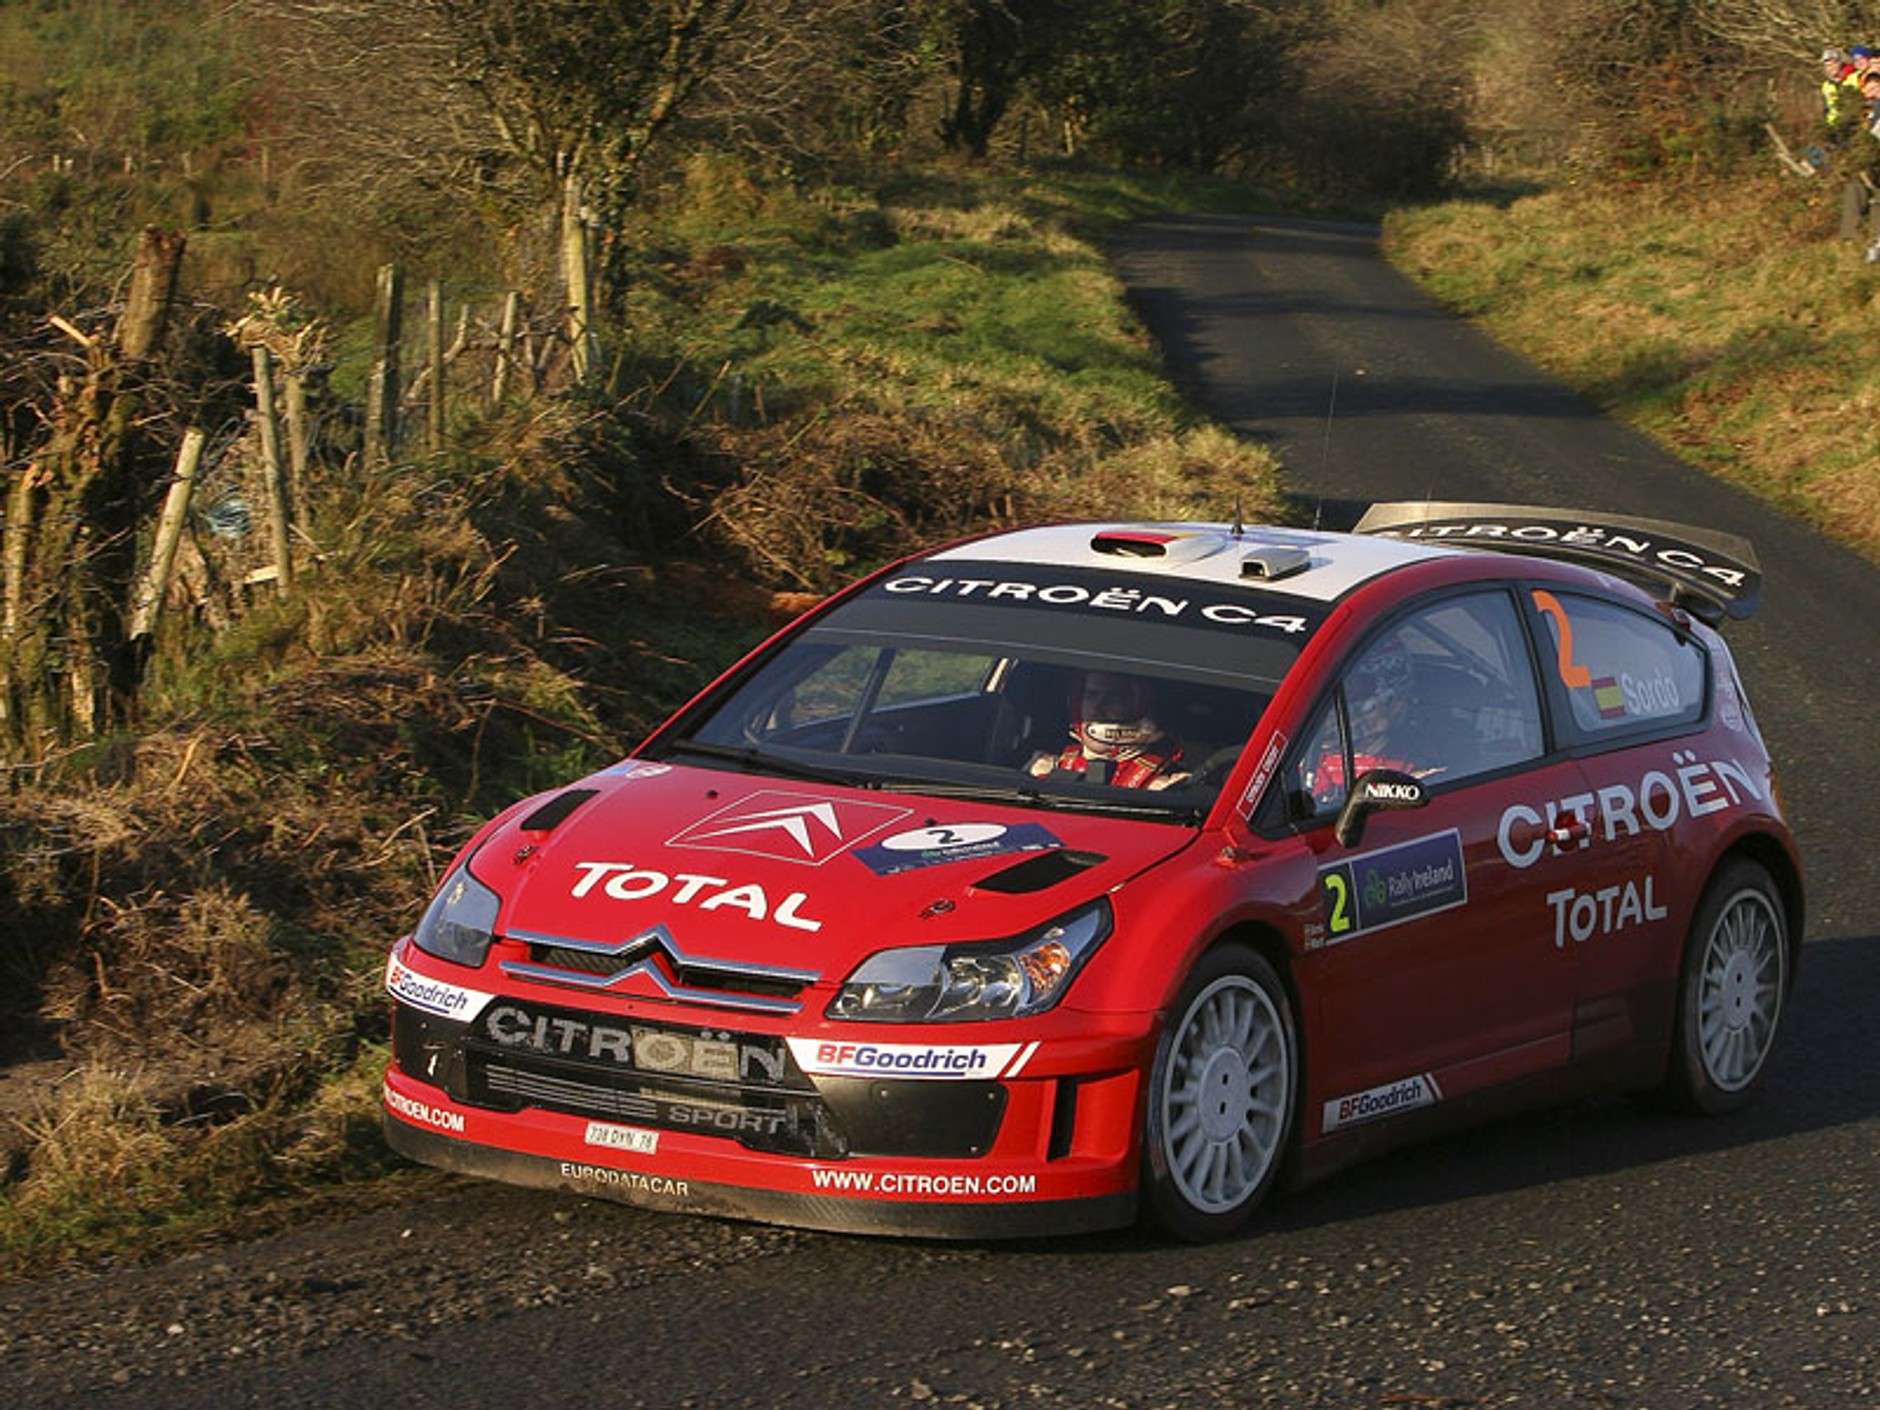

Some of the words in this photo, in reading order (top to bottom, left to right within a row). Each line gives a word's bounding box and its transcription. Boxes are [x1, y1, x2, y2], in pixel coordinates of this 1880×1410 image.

[1657, 549, 1745, 587] C4
[884, 576, 1188, 616] CITROËN
[1201, 604, 1308, 633] C4
[1531, 590, 1591, 688] 2
[1621, 667, 1679, 715] Sordo
[1365, 783, 1420, 800] NIKKO
[1497, 750, 1763, 868] CITROËN
[927, 829, 963, 844] 2
[571, 861, 822, 932] TOTAL
[1325, 874, 1349, 932] 2
[1546, 875, 1667, 948] TOTAL
[486, 1005, 786, 1083] CITROËN
[816, 1044, 987, 1070] BFGoodrich
[668, 1105, 786, 1135] SPORT
[1339, 1081, 1421, 1120] BFGoodrich
[561, 1162, 687, 1196] EURODATACAR
[812, 1170, 1036, 1194] WWW.CITROEN.COM
